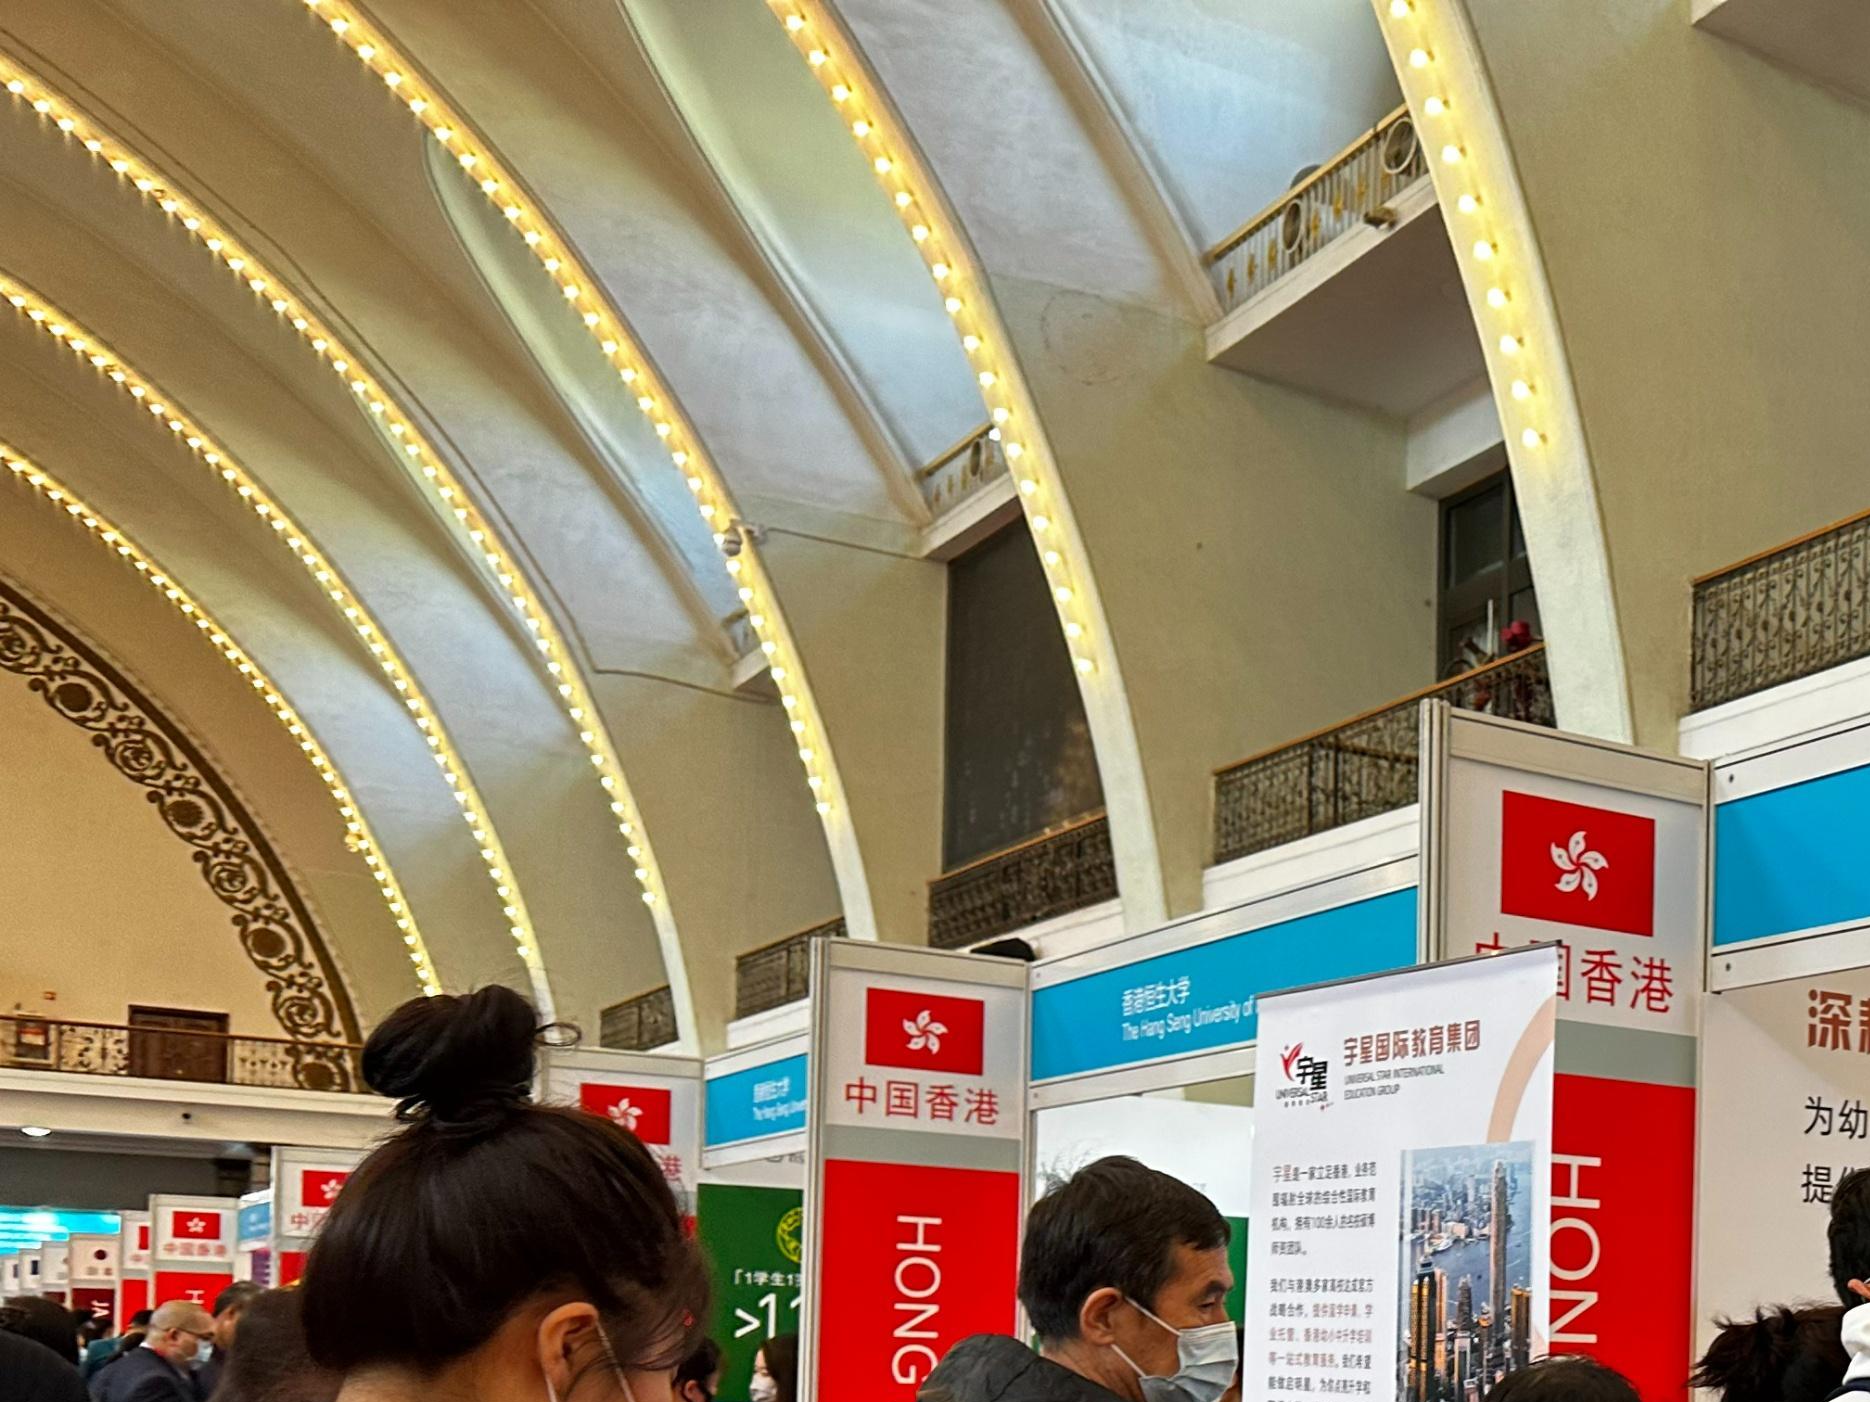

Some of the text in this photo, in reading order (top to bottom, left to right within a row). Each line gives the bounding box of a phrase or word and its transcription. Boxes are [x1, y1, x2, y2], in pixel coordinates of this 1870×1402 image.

[1193, 1000, 1241, 1027] University
[1344, 1020, 1480, 1067] 宇星国际教育集团
[1296, 1055, 1328, 1091] 宇星
[845, 1077, 1000, 1126] 中国香港
[1549, 1153, 1602, 1344] HON
